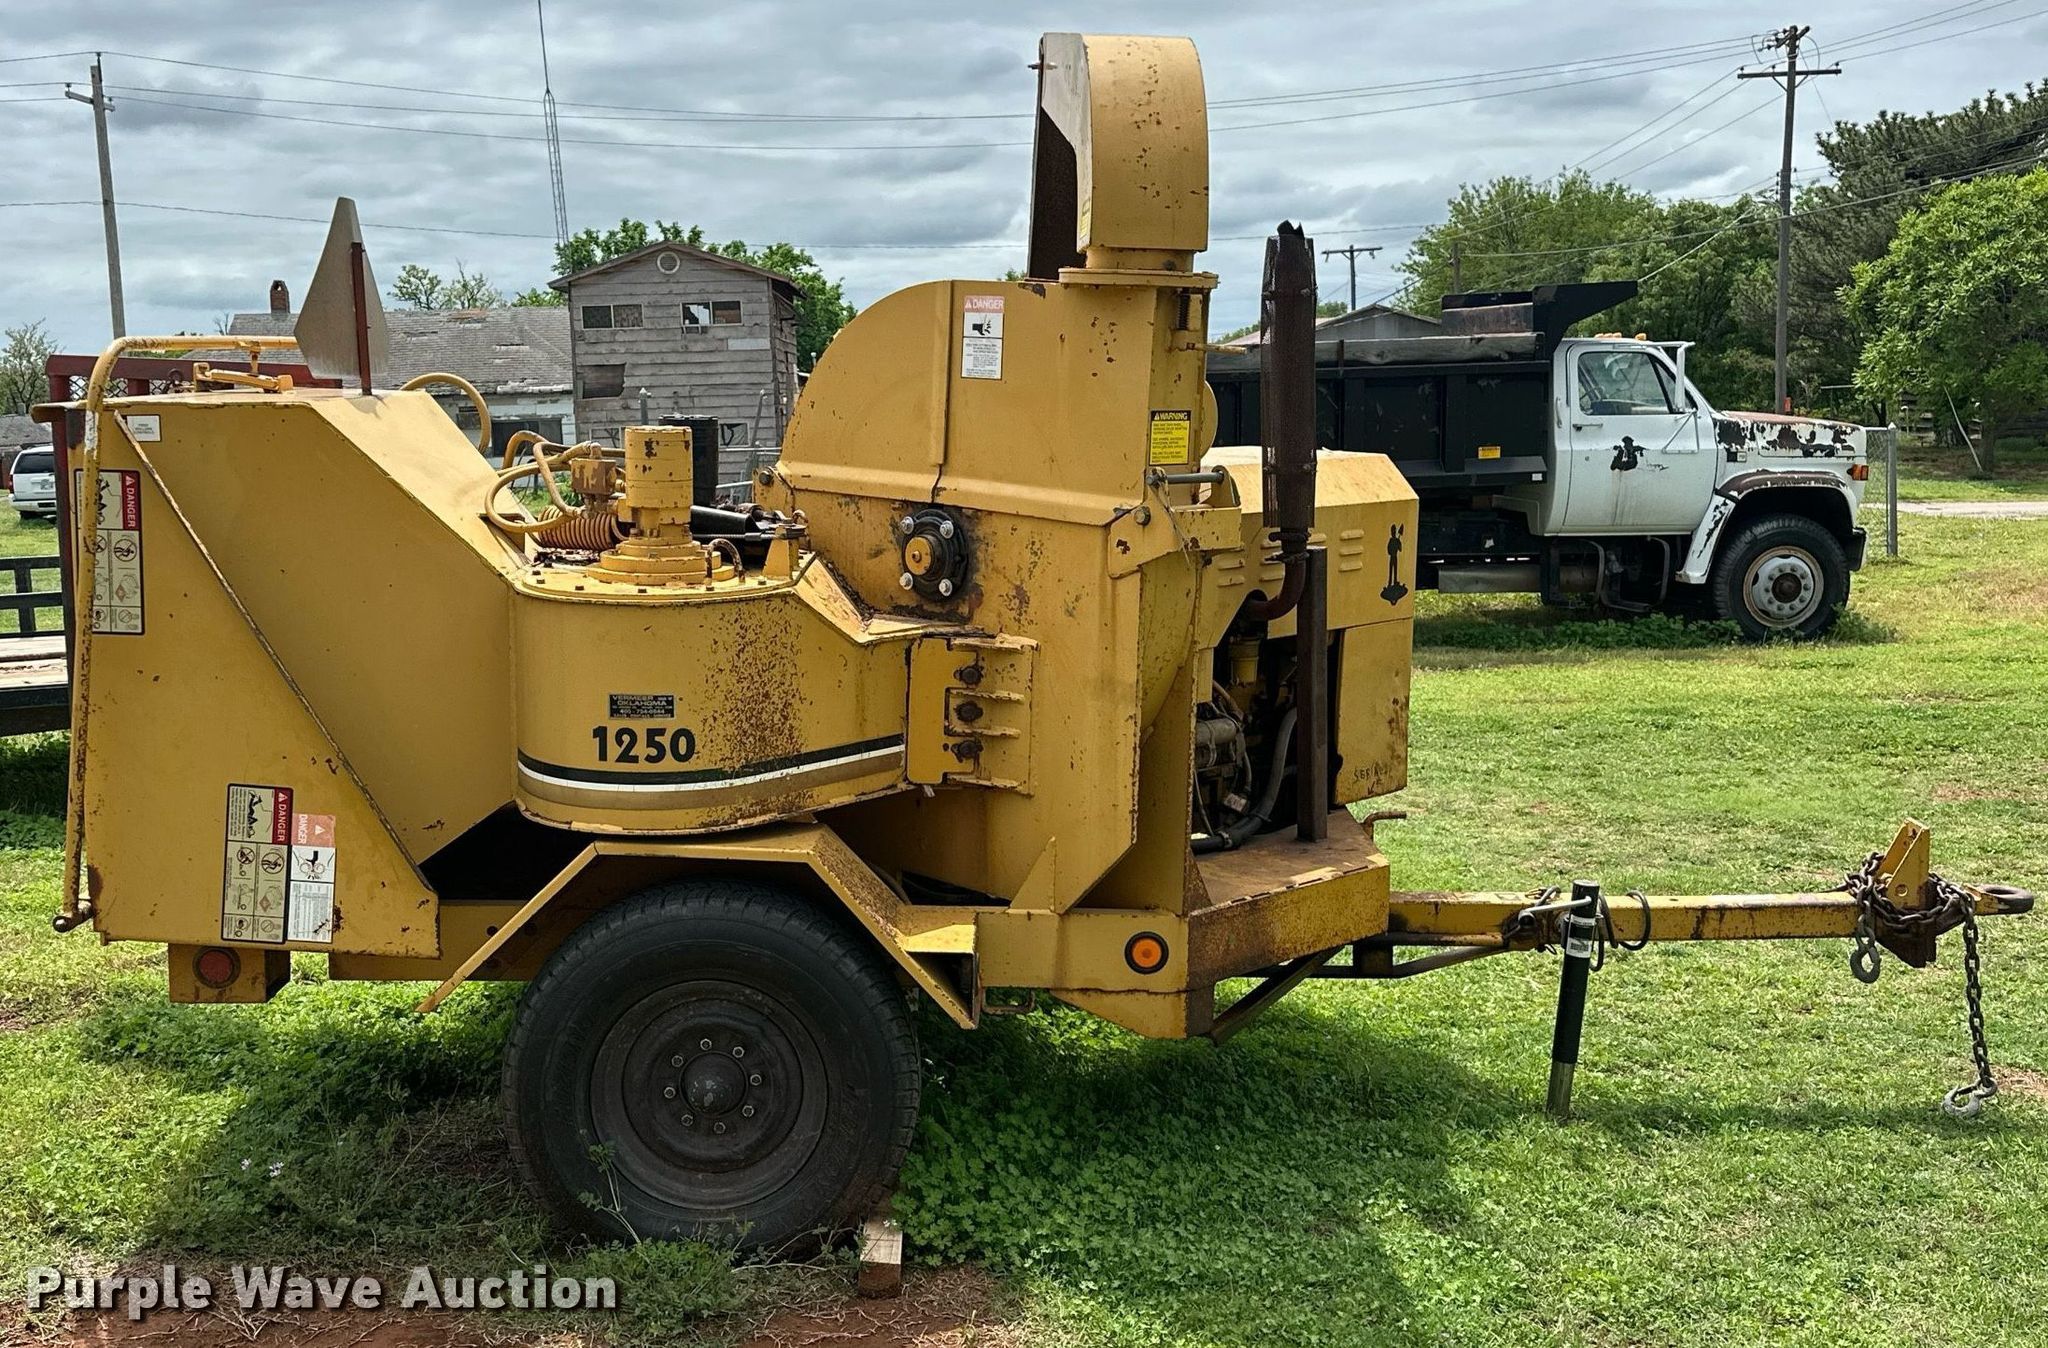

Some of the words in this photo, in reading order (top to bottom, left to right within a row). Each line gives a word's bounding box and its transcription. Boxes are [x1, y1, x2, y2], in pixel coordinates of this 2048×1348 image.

[972, 299, 1003, 310] DANGER
[1160, 412, 1188, 420] WARNING
[125, 487, 136, 528] DANGER
[592, 725, 696, 763] 1250
[277, 803, 287, 842] DANGER
[297, 814, 308, 844] DANGER
